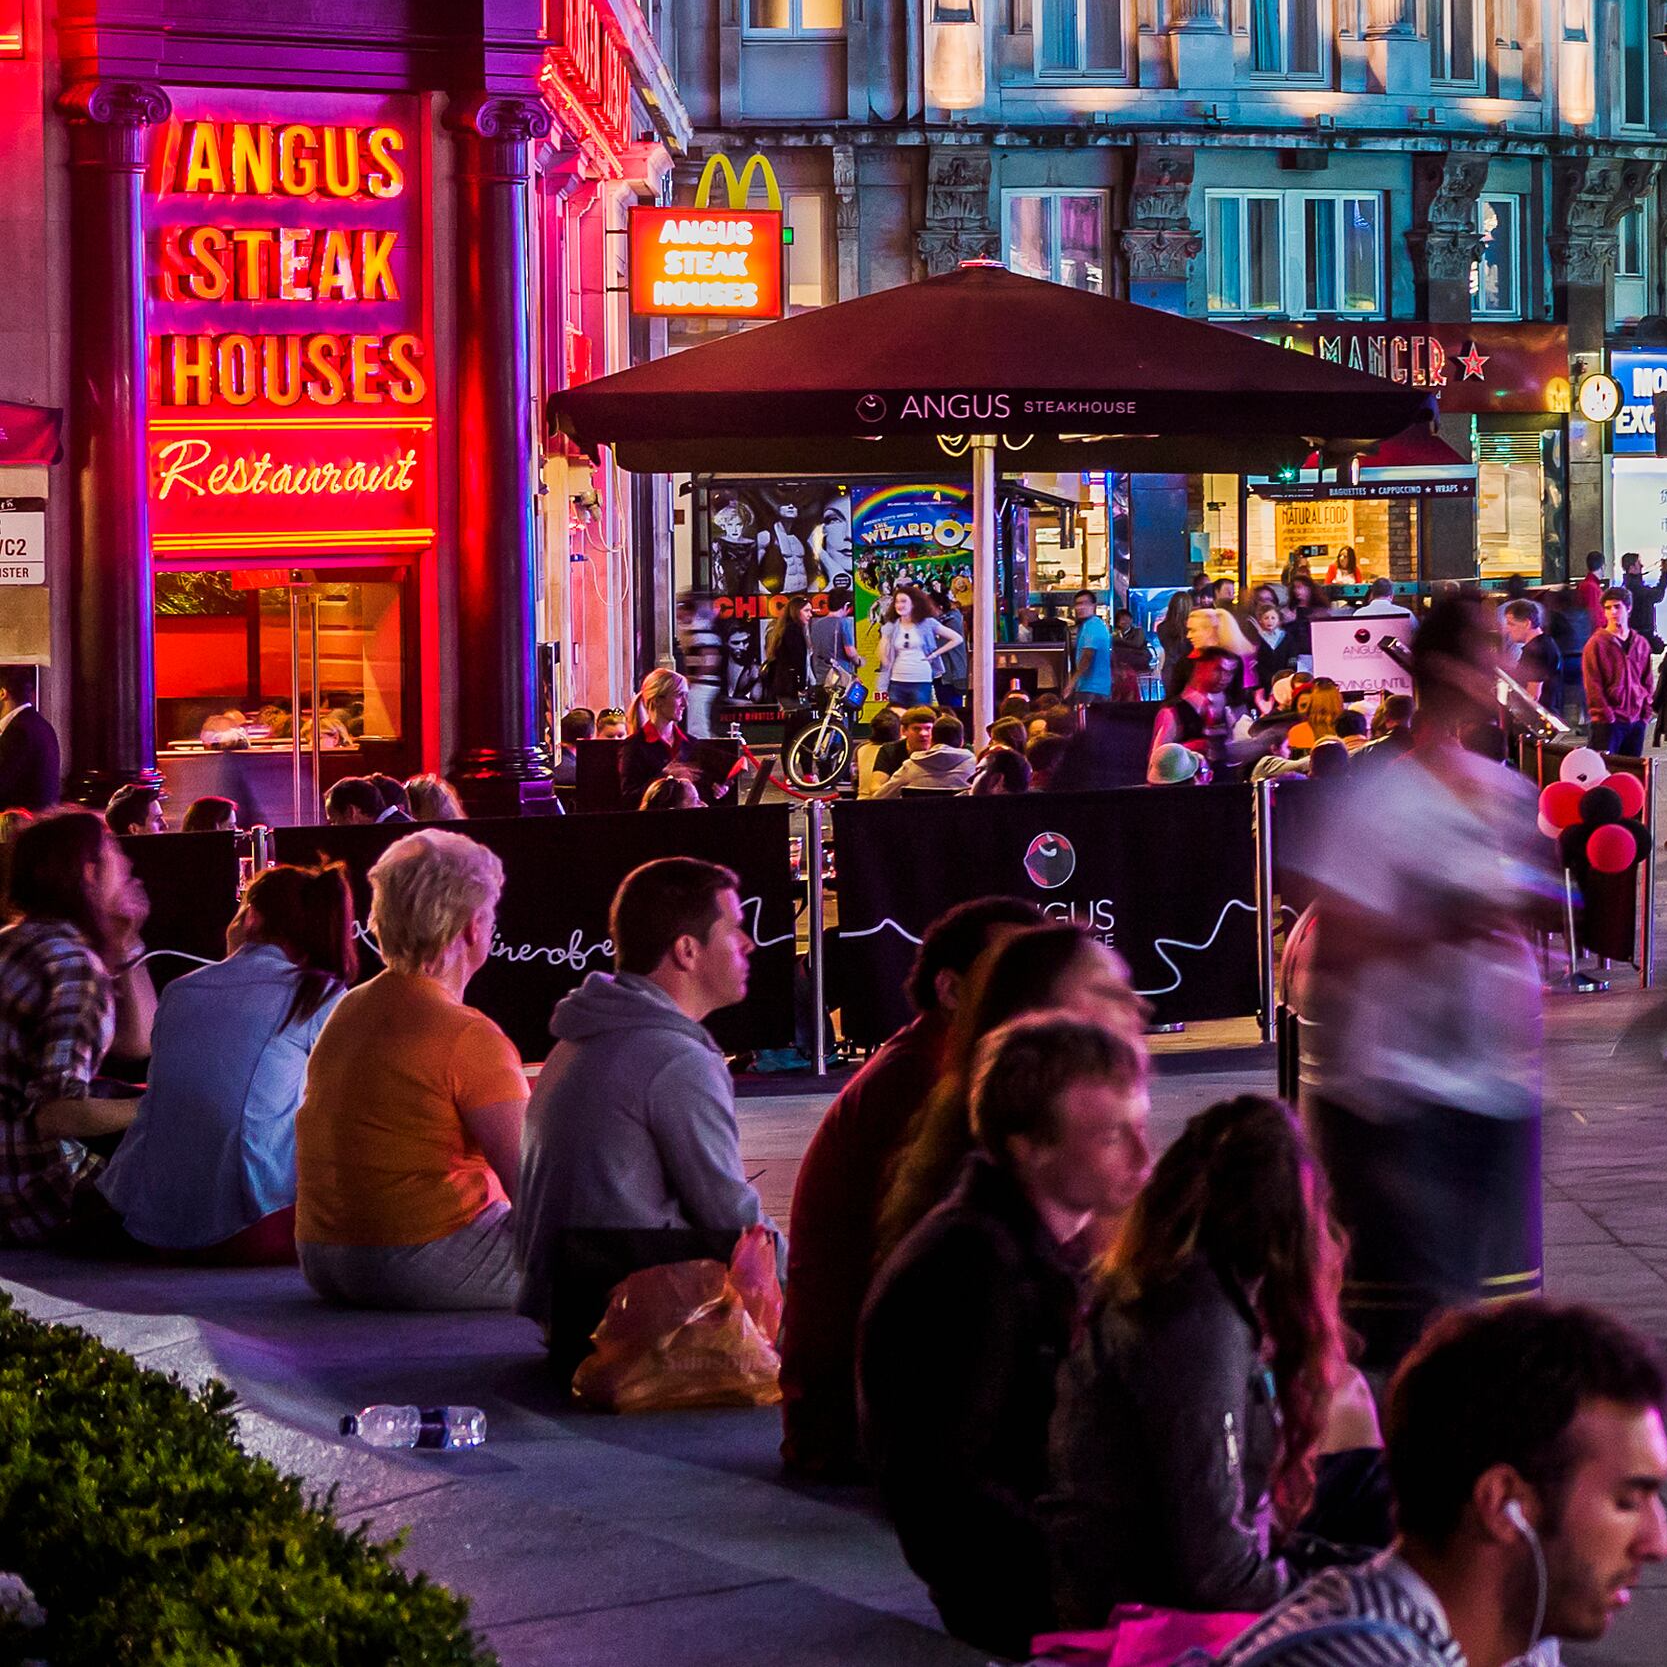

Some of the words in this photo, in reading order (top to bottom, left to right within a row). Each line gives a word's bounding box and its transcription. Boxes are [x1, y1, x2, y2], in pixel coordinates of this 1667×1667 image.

[182, 121, 404, 199] ANGUS
[659, 219, 754, 245] ANGUS
[187, 226, 400, 302] STEAK
[664, 250, 749, 276] STEAK
[653, 280, 759, 307] HOUSES
[172, 334, 426, 406] HOUSES
[900, 394, 1011, 420] ANGUS
[1024, 401, 1137, 414] STEAKHOUSE
[157, 438, 418, 500] Restaurant
[1328, 487, 1367, 496] BAGUETTES
[1378, 485, 1422, 495] CAPPUCCINO
[1434, 484, 1459, 493] WRAPS
[1281, 507, 1323, 526] NATURAL
[1325, 506, 1349, 524] FOOD
[860, 522, 934, 544] WIZARD
[712, 594, 852, 619] CHICG
[1343, 646, 1384, 655] ANGUS
[1374, 677, 1410, 689] UNTIL
